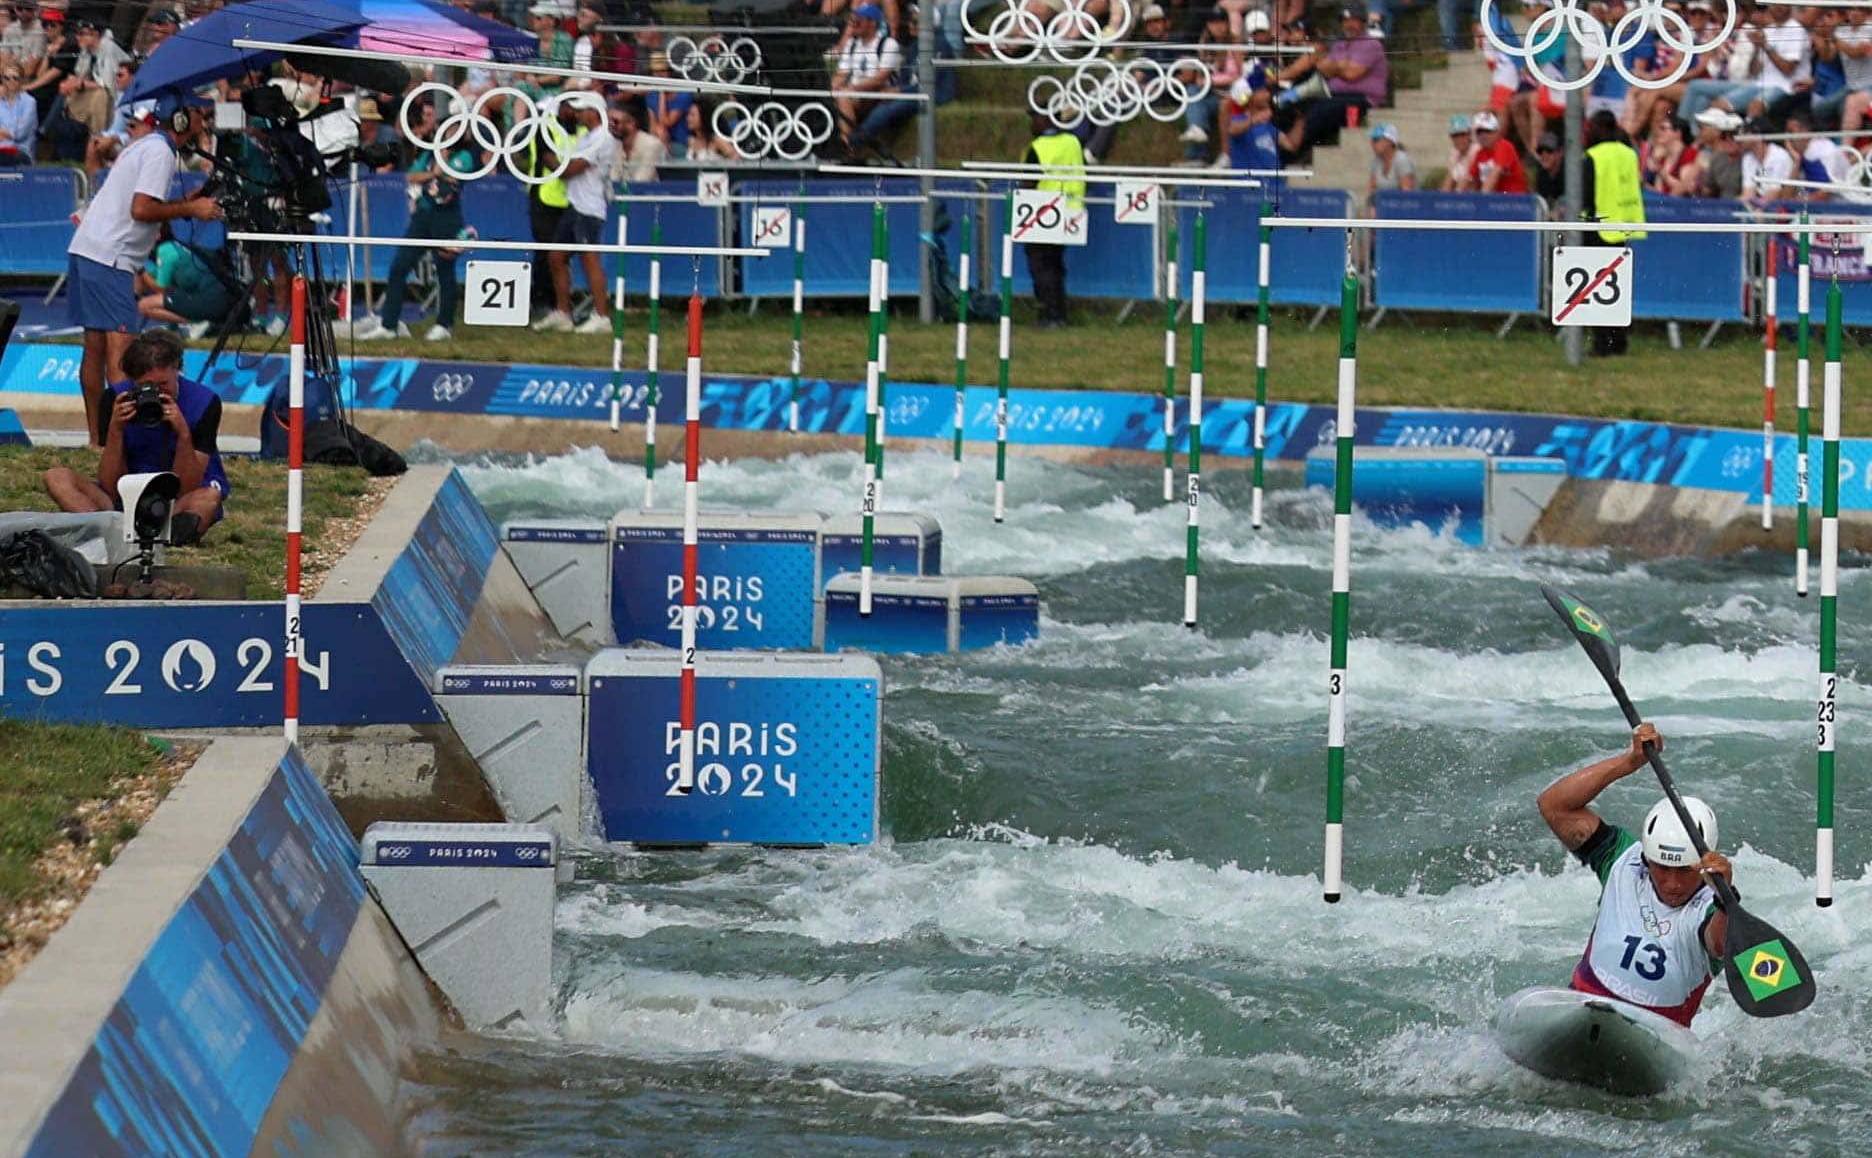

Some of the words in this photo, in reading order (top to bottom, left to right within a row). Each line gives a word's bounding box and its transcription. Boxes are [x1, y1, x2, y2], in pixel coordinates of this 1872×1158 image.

[1125, 192, 1149, 212] 18
[1017, 203, 1060, 229] 20
[481, 277, 515, 309] 21
[1565, 267, 1620, 305] 23
[867, 483, 875, 496] 2
[290, 617, 299, 634] 2
[667, 605, 763, 631] 2024
[104, 638, 330, 695] 2024
[686, 648, 694, 664] 2
[1331, 674, 1340, 695] 3
[1827, 678, 1835, 698] 2
[1818, 701, 1834, 722] 23
[1818, 725, 1825, 745] 3
[665, 762, 797, 797] 2024
[429, 848, 463, 858] PARIS
[1660, 852, 1682, 862] BRA
[1619, 935, 1667, 981] 13
